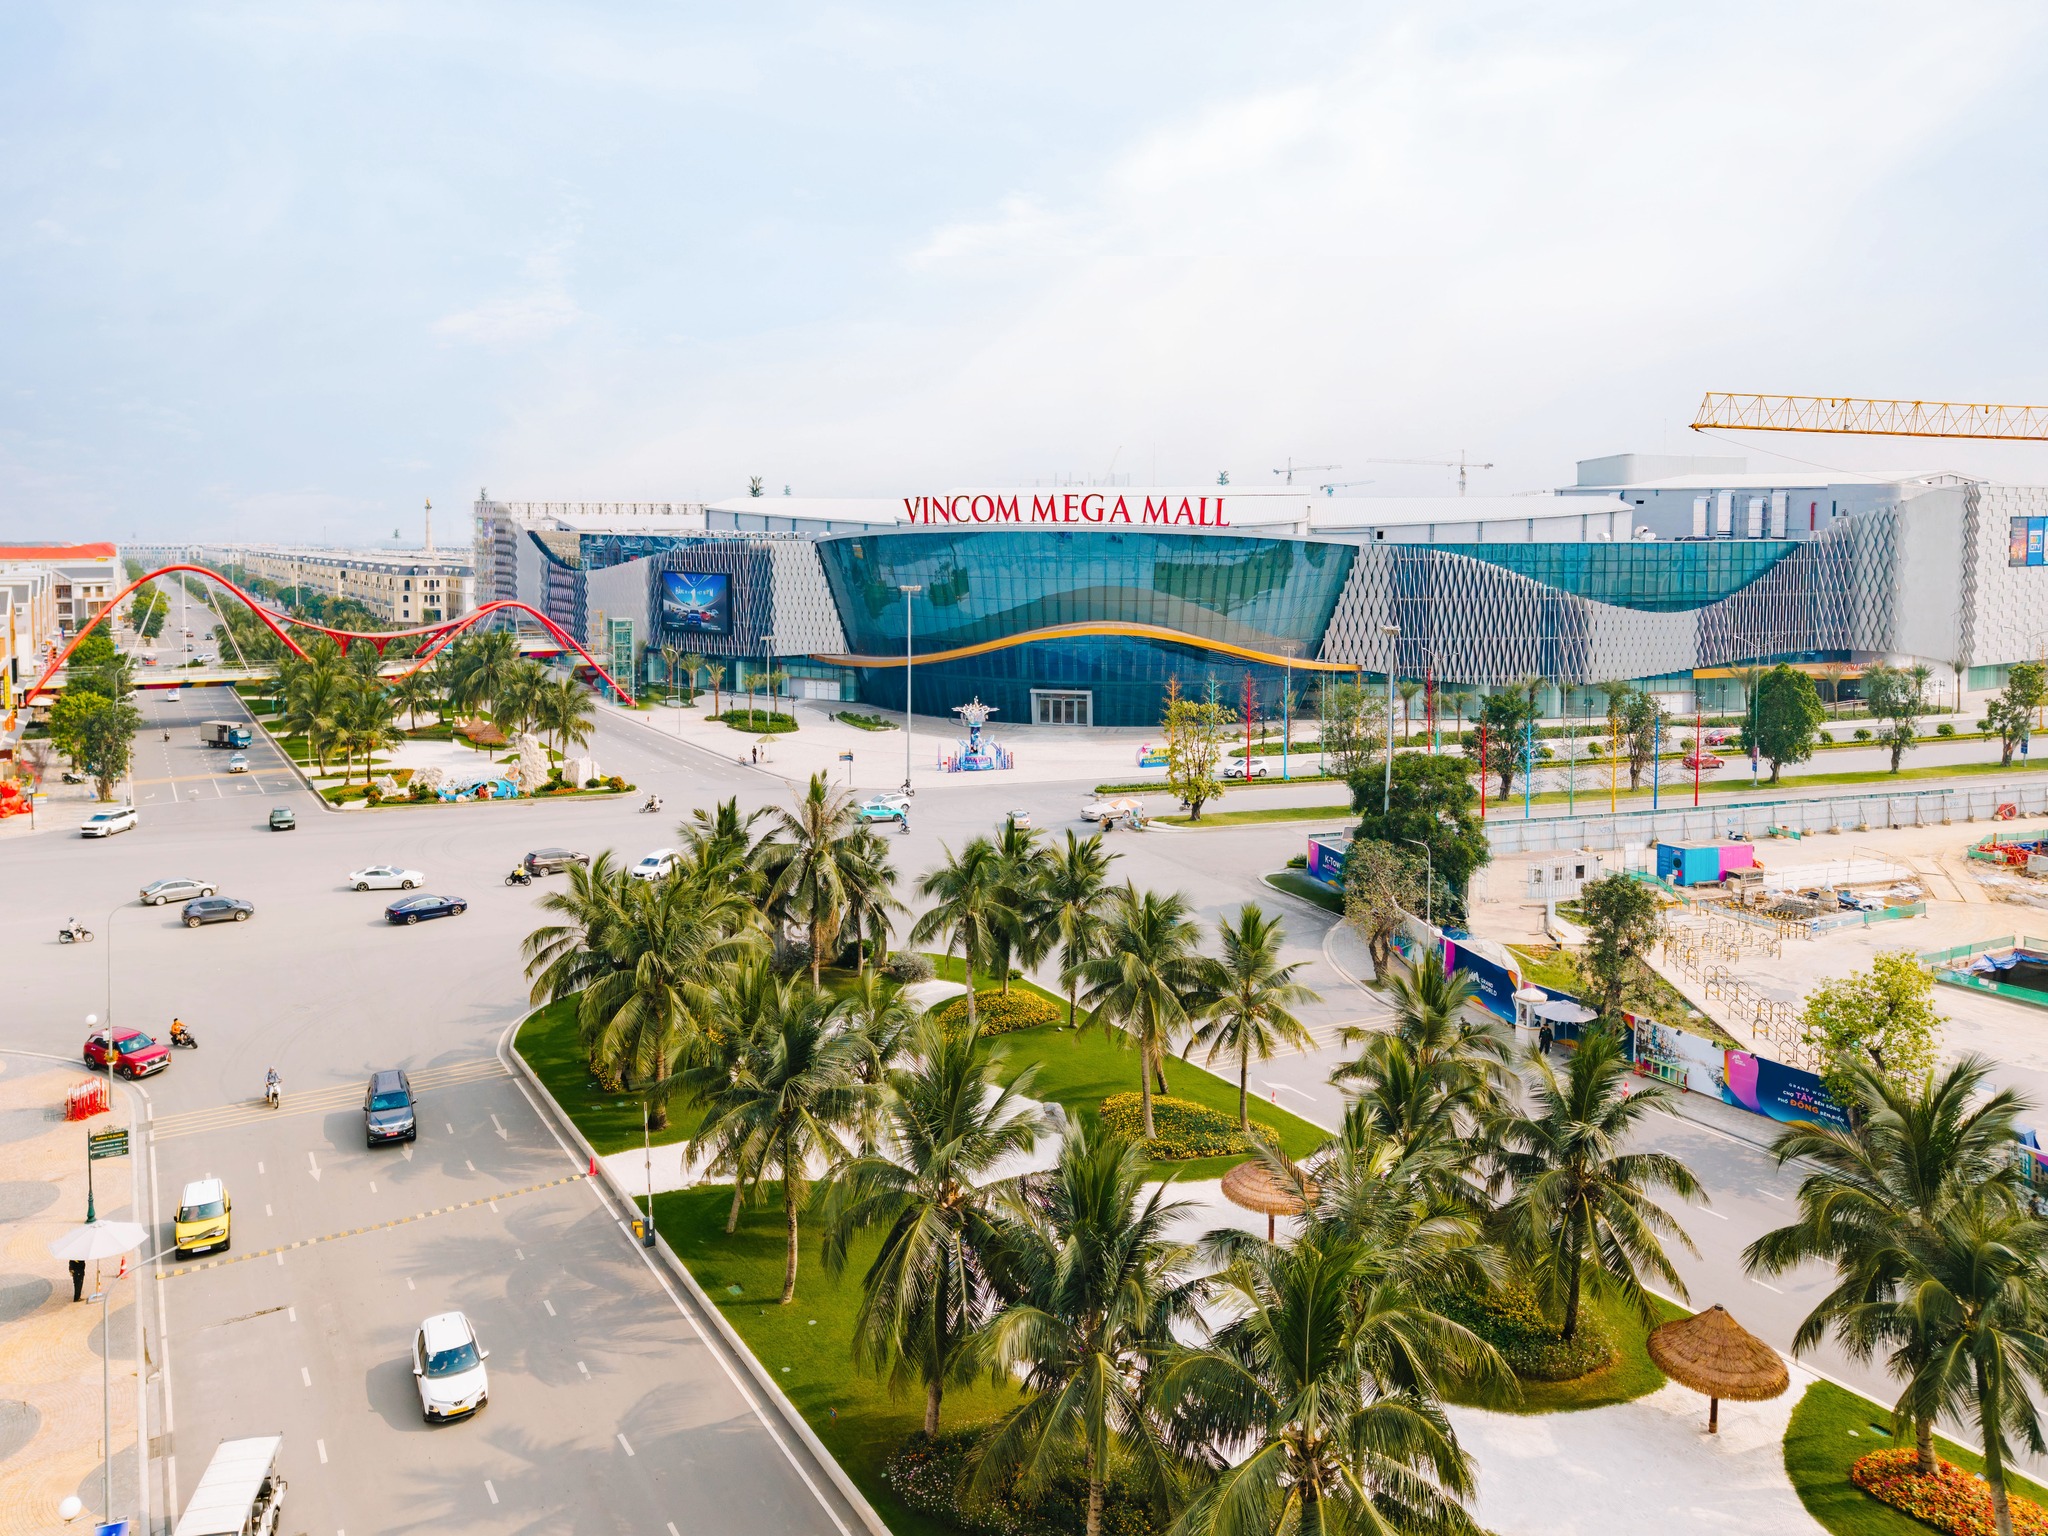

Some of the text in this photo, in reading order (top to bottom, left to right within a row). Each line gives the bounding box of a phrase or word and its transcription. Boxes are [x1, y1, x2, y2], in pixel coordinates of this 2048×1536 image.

[903, 493, 1230, 527] VINCOM MEGA MALL
[1480, 977, 1494, 988] GRAND
[1480, 984, 1497, 997] WORLD
[1788, 1082, 1810, 1093] GRAND
[1782, 1090, 1794, 1098] CHỢ
[1795, 1091, 1814, 1103] TÂY
[1789, 1098, 1819, 1114] ĐÔNG
